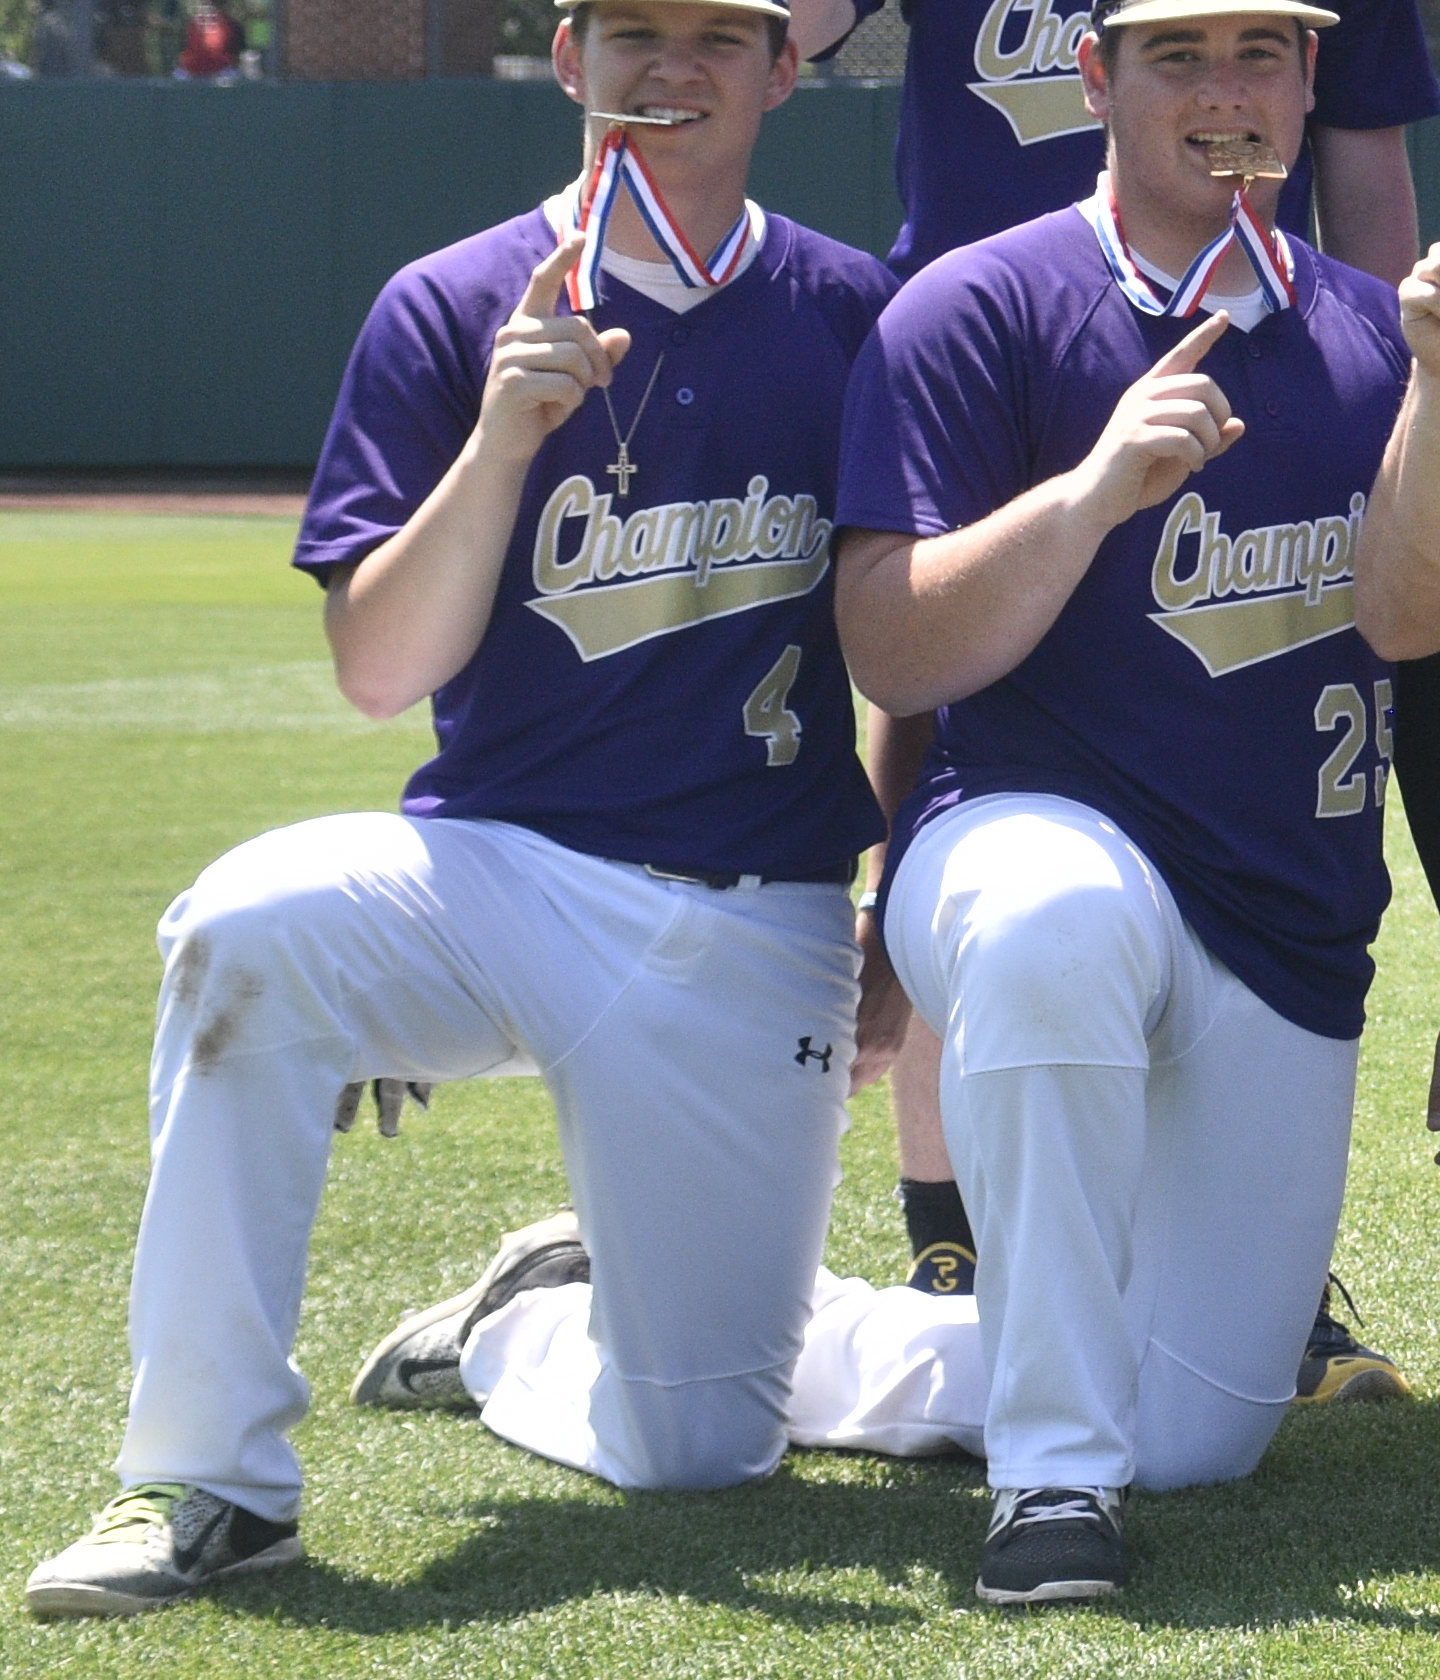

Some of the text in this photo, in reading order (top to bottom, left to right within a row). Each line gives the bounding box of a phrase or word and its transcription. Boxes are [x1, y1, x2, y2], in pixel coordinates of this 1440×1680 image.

[533, 474, 833, 594] Champion
[1151, 491, 1368, 611] Champi
[742, 645, 801, 767] 4
